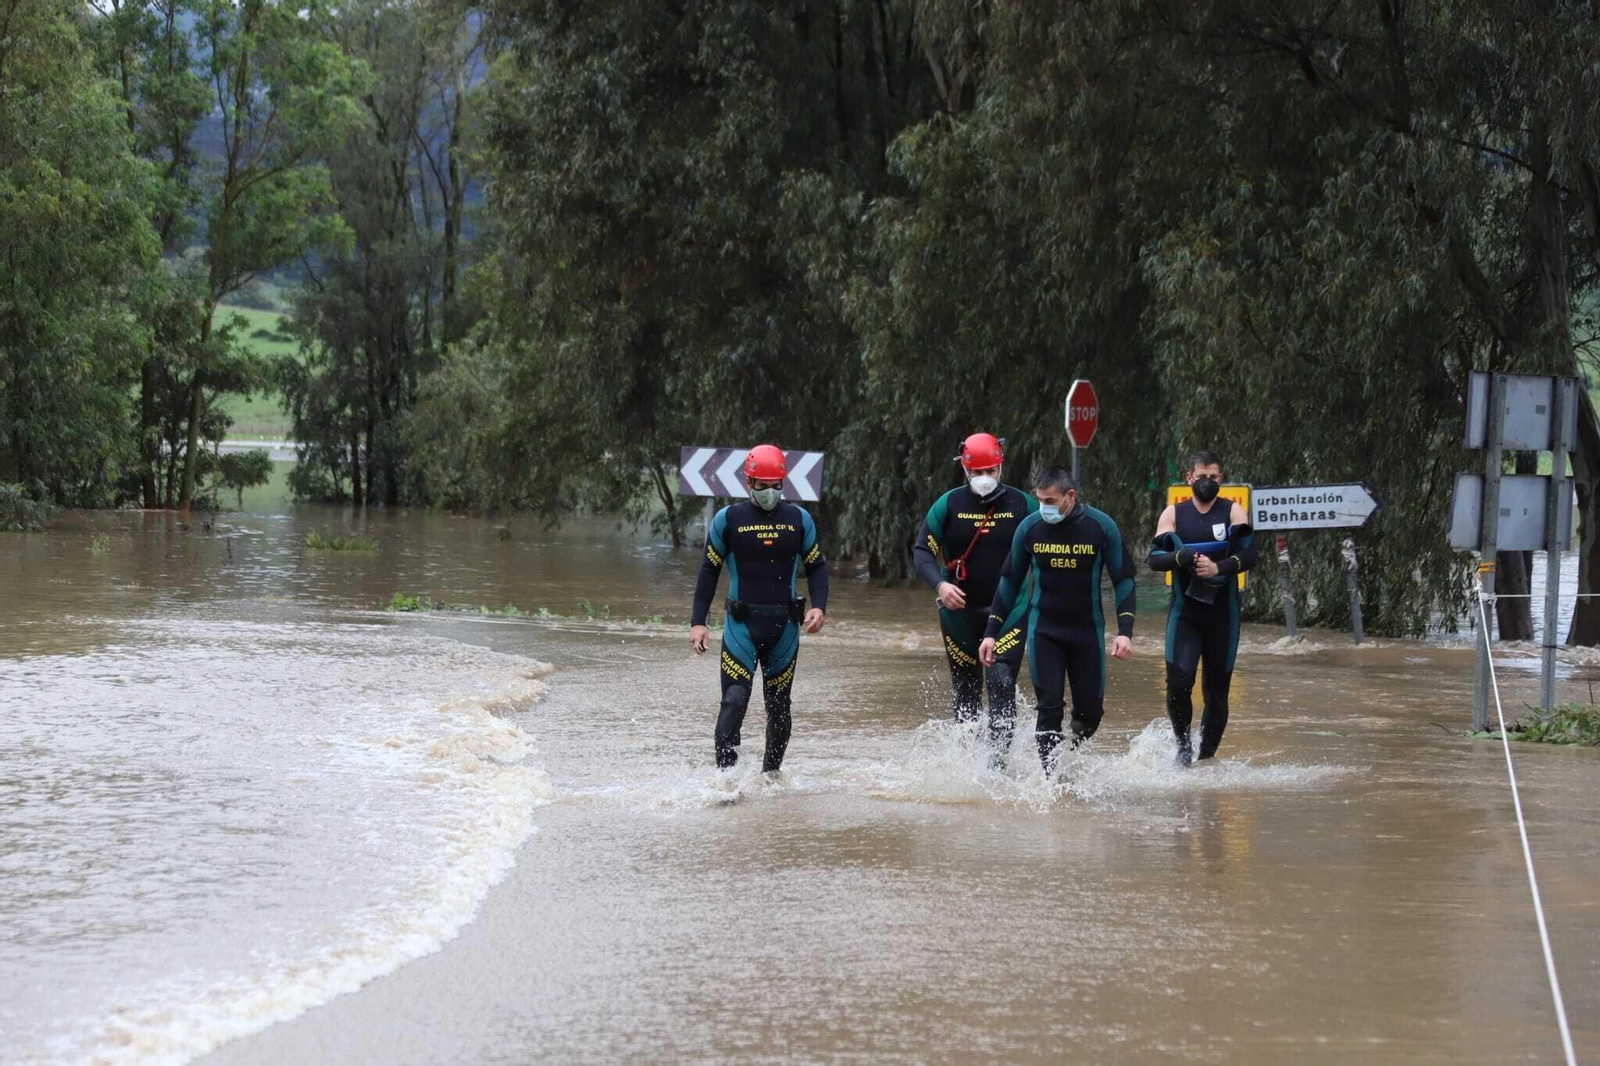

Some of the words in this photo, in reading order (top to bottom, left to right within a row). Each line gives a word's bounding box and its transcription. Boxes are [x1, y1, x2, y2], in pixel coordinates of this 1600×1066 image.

[1070, 407, 1096, 421] STOP
[1257, 493, 1343, 506] urbanización
[993, 511, 1014, 519] CIVIL
[1257, 510, 1337, 523] Benharas
[738, 524, 774, 533] GUARDIA
[1033, 543, 1071, 554] GUARDIA
[1072, 544, 1095, 555] CIVIL
[1050, 558, 1077, 569] GEAS
[993, 628, 1022, 651] ARDIA
[945, 635, 977, 666] GUARDIA
[996, 639, 1020, 654] CIVIL
[721, 651, 751, 681] GUARDIA
[721, 662, 738, 680] CIVIL
